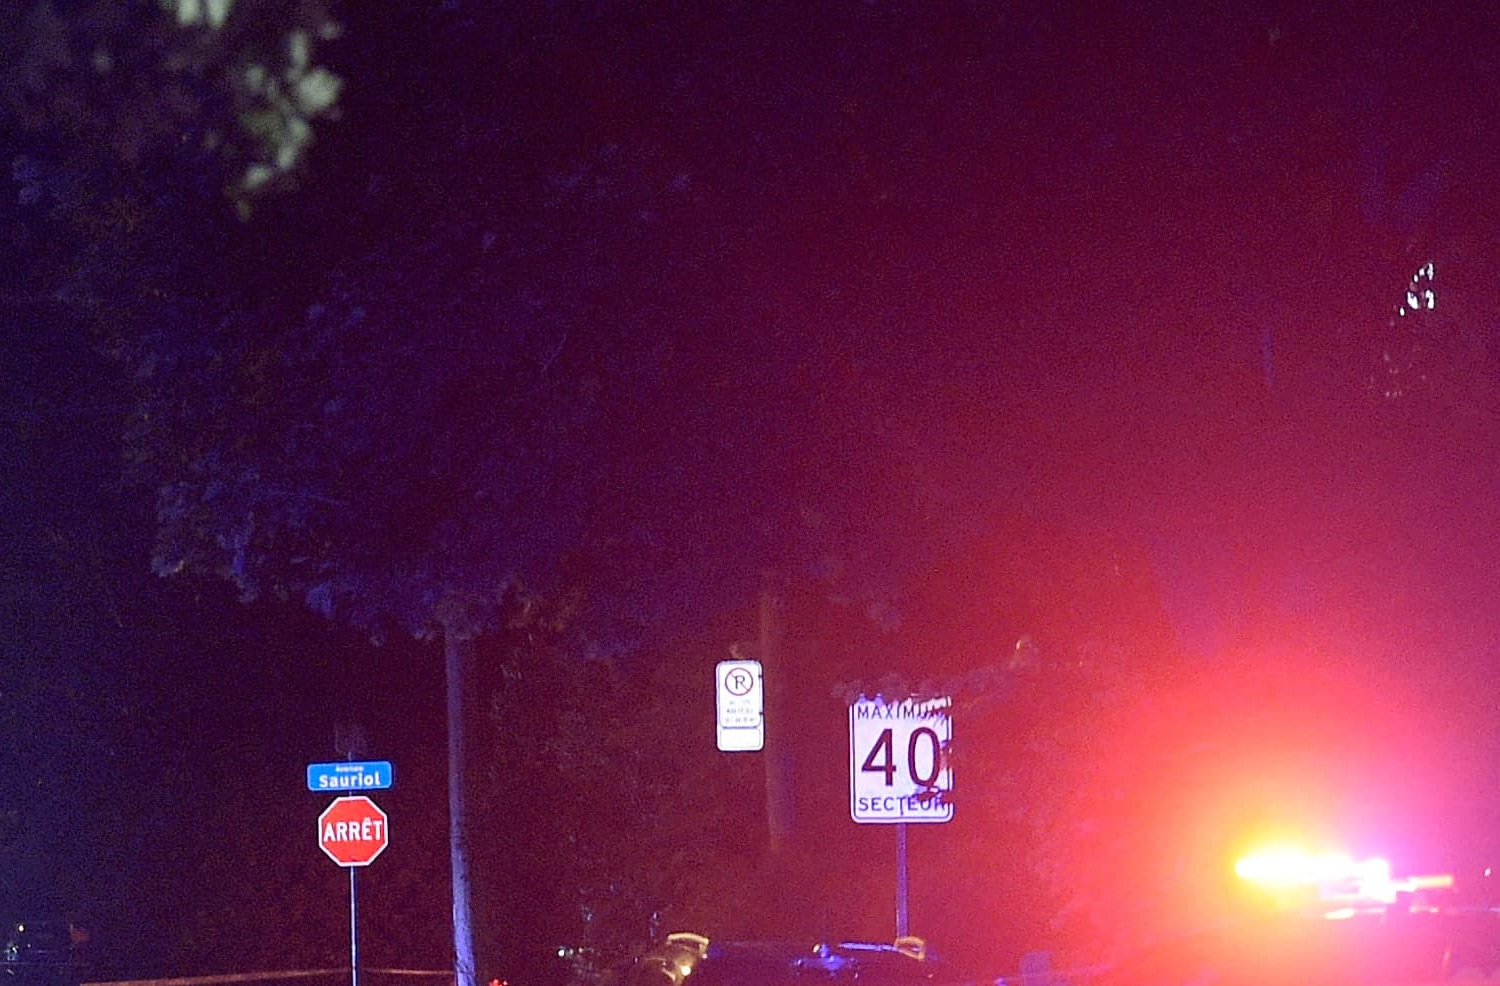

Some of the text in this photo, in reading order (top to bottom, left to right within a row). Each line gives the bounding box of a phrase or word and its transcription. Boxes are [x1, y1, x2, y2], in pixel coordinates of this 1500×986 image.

[861, 726, 940, 787] 40
[319, 771, 380, 788] Sauriol
[323, 817, 383, 842] ARRÊT
